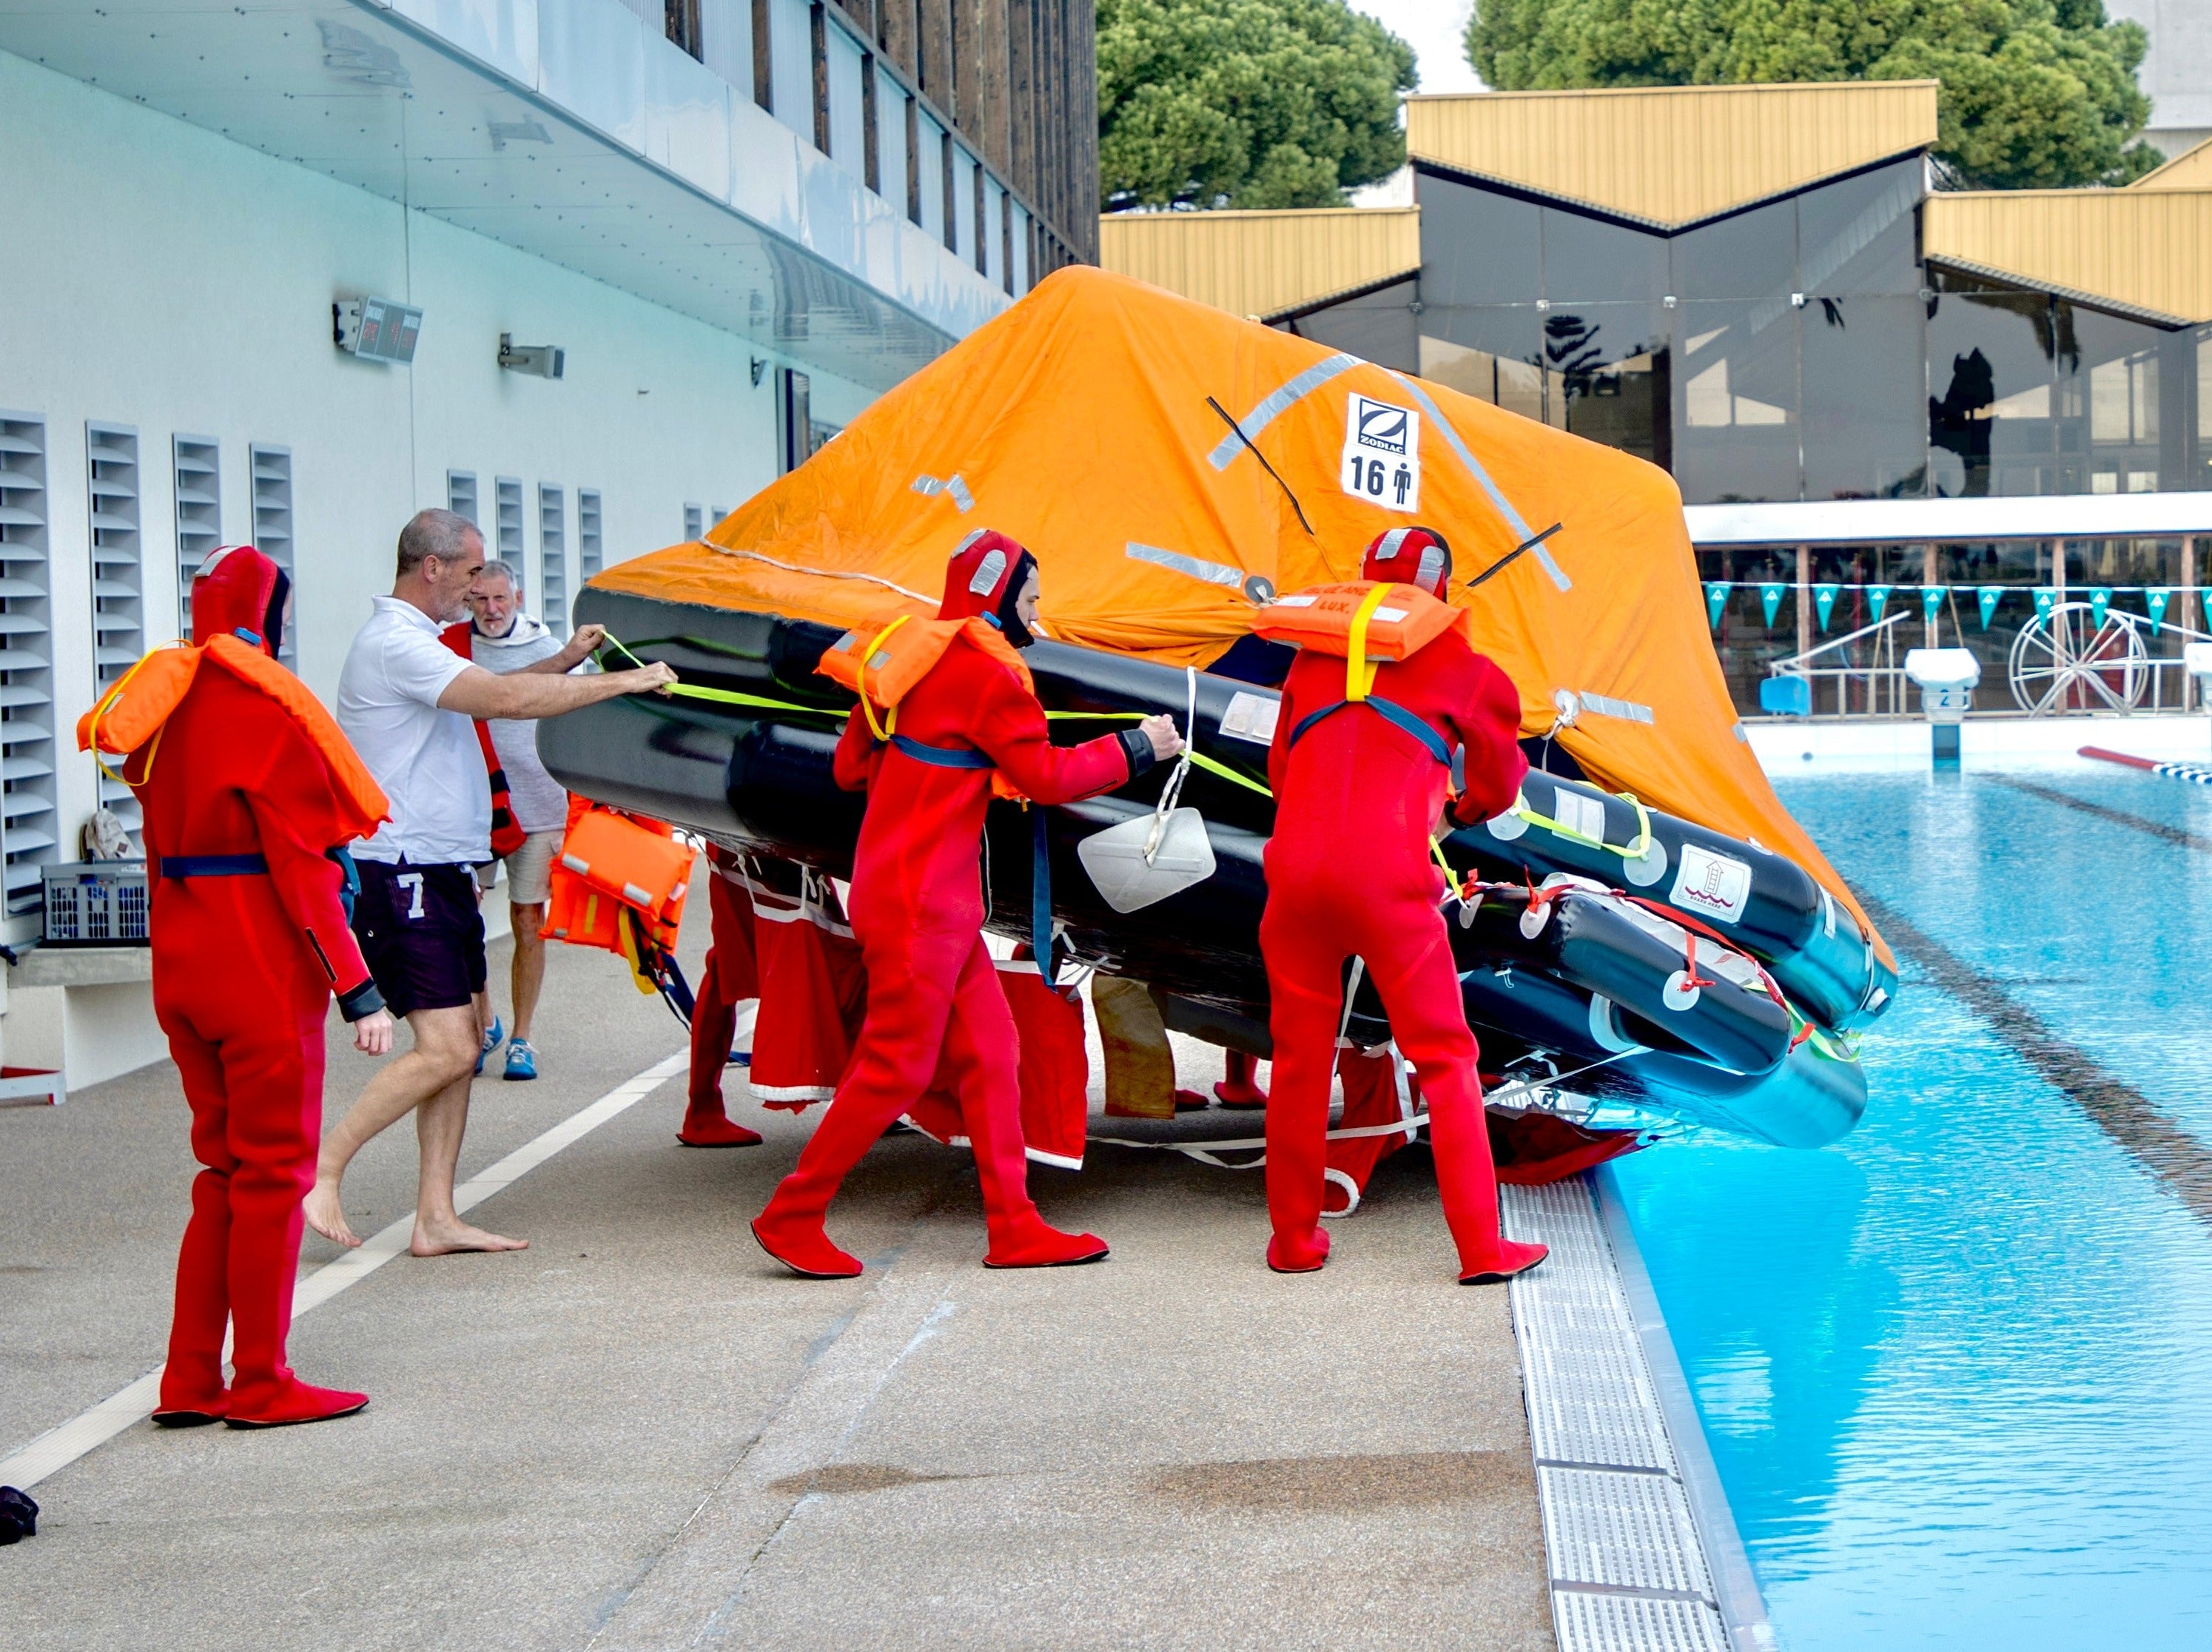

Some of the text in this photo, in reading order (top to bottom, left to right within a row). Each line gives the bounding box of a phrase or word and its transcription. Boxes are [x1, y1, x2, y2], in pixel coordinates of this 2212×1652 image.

[1360, 435, 1404, 454] ZODIAC
[1351, 456, 1385, 496] 16
[1940, 689, 1949, 705] 2
[397, 873, 425, 919] 7
